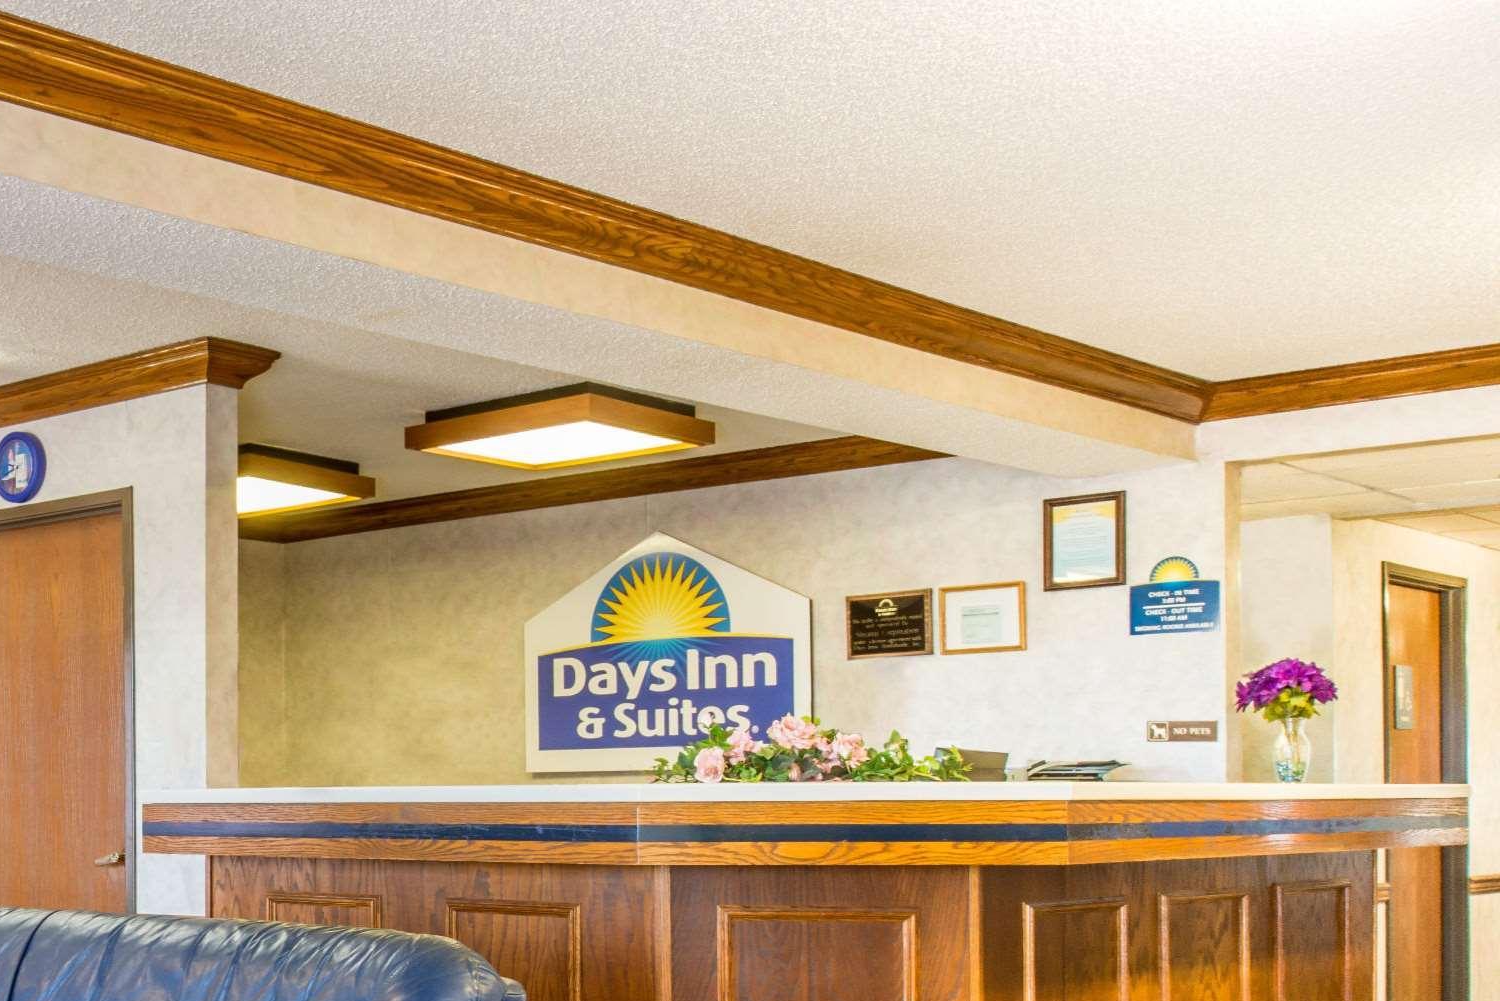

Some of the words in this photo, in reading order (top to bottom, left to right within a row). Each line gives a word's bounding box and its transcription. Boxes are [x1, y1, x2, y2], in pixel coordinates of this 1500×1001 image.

[553, 657, 677, 700] Days
[687, 649, 778, 690] Inn
[576, 707, 606, 739] &
[1172, 727, 1187, 735] NO
[1189, 727, 1211, 735] PETS
